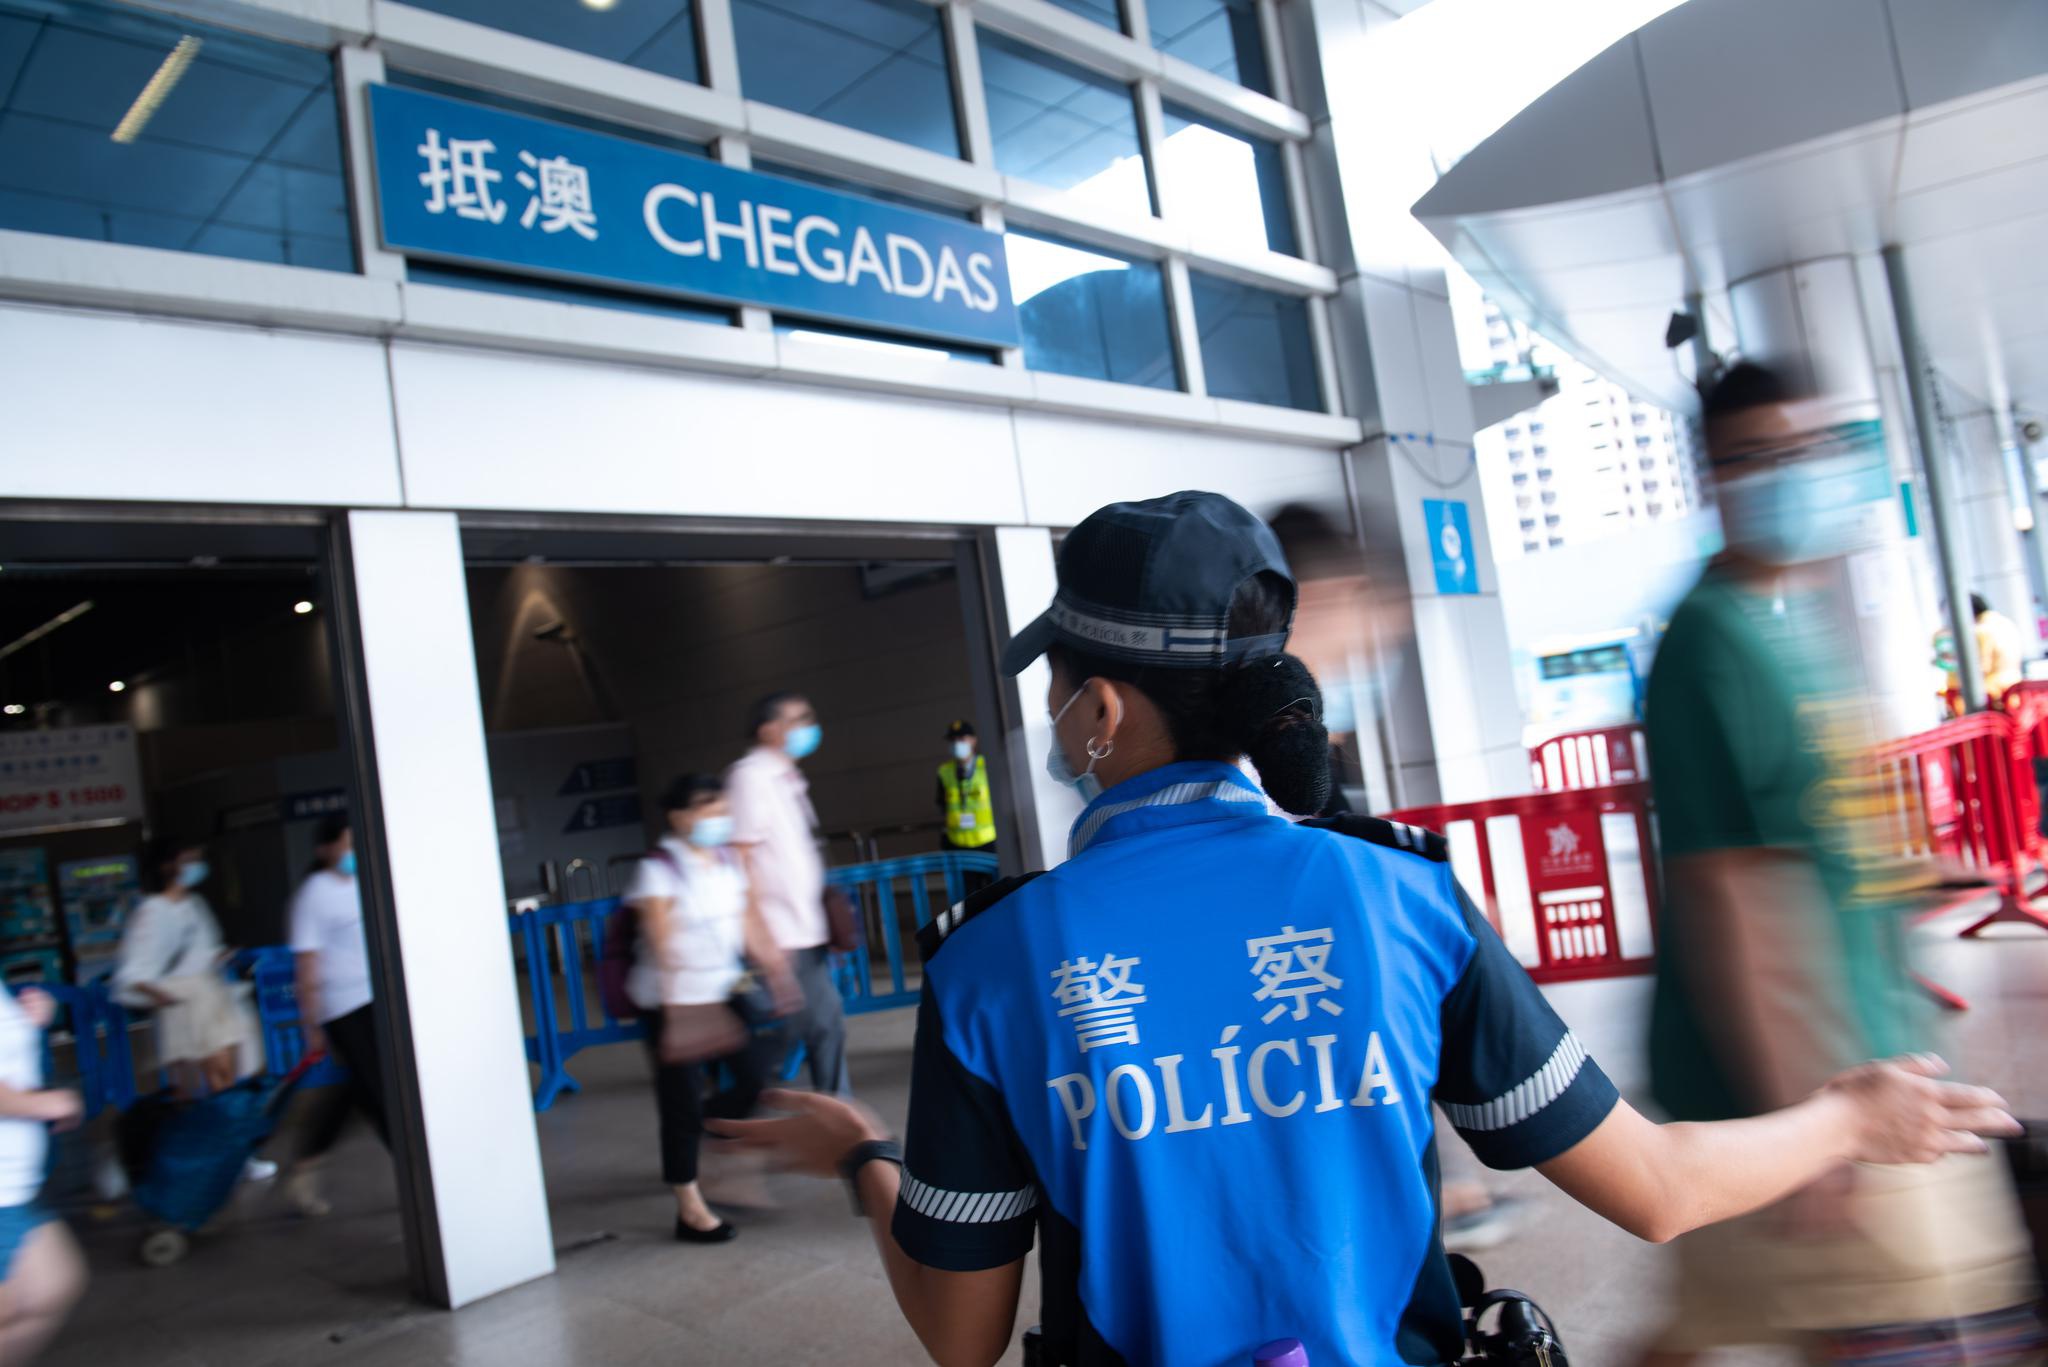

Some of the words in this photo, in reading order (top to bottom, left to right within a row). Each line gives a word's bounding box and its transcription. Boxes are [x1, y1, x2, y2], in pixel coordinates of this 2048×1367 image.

[417, 128, 599, 242] 抵澳
[642, 183, 998, 312] CHEGADAS
[1050, 952, 1148, 1054] 警
[1246, 925, 1345, 1025] 察
[1047, 1025, 1402, 1151] POLÍCIA
